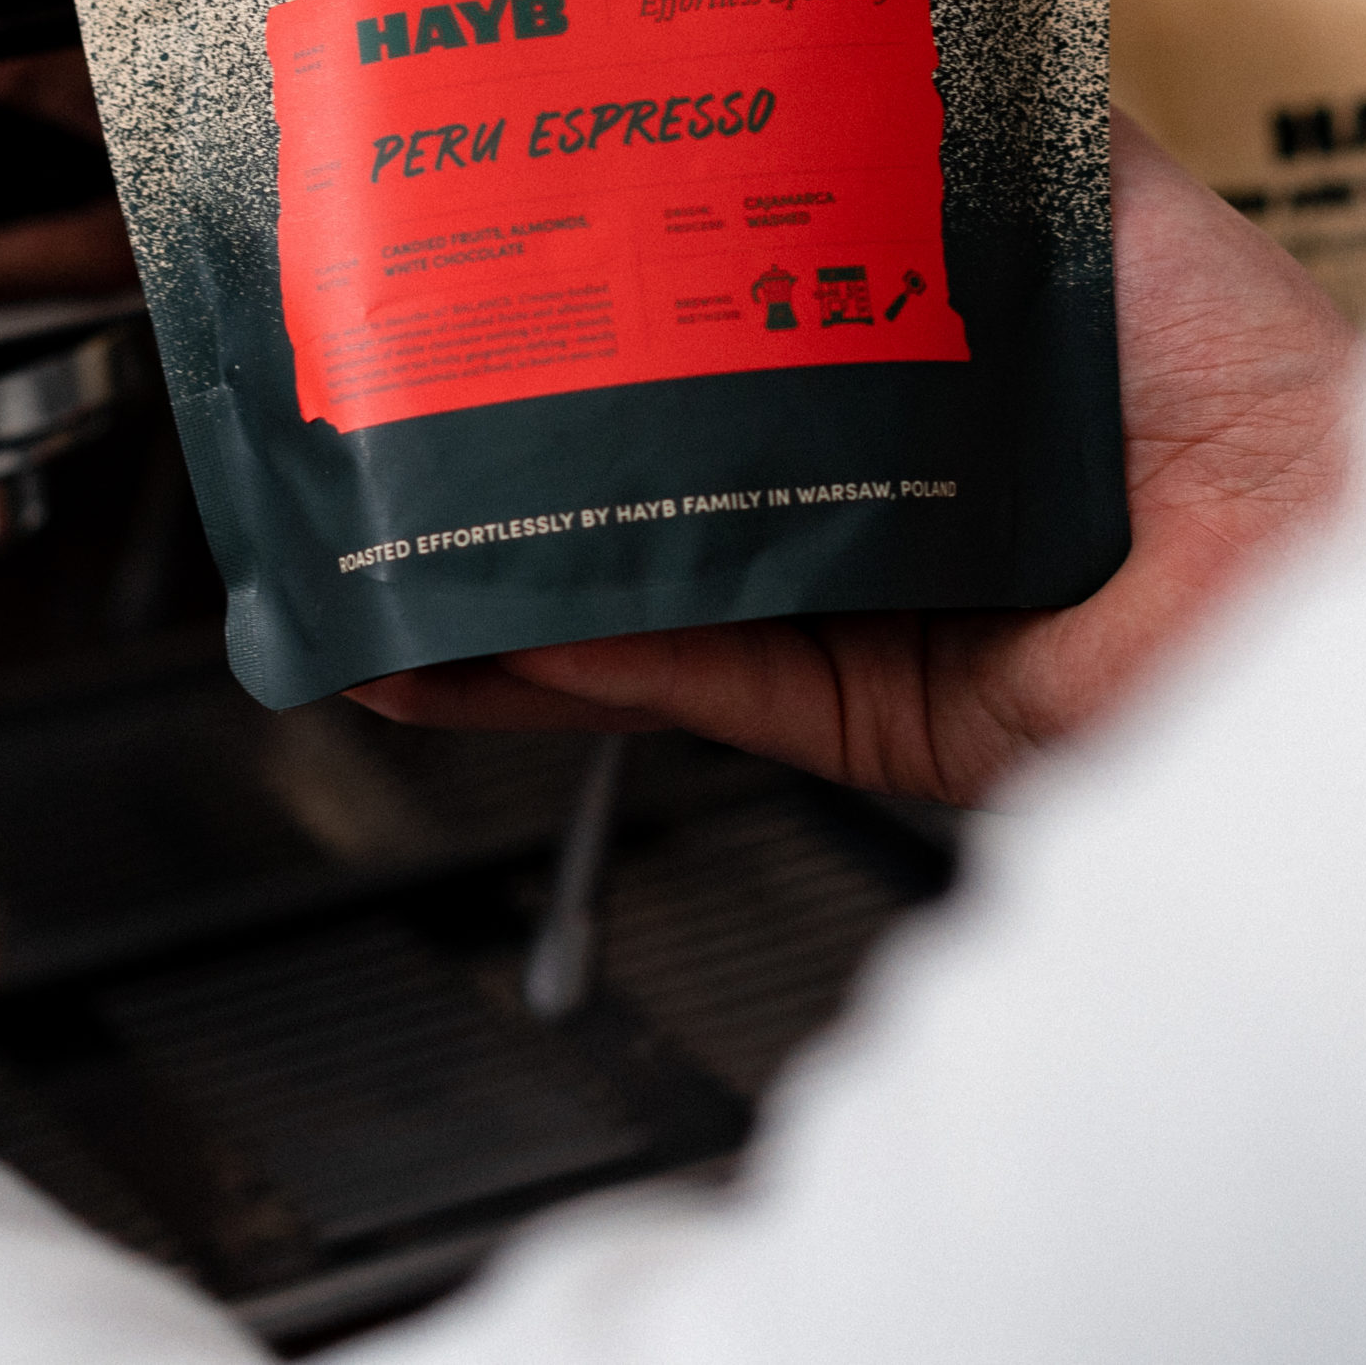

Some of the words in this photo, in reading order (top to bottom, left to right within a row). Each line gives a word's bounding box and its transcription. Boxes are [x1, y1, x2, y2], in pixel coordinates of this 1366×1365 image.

[370, 118, 506, 183] PERU
[529, 89, 776, 159] ESPRESSO
[381, 236, 448, 260] CANDIED
[384, 258, 429, 277] WHITE
[433, 242, 525, 270] CHOCOLATE
[338, 540, 411, 574] ROASTED
[416, 511, 575, 556] EFFORTLESSLY
[580, 507, 610, 529] BY
[615, 498, 677, 523] HAYB
[682, 490, 762, 515] FAMILY
[768, 488, 791, 507] IN
[796, 481, 897, 505] WARSAW,
[900, 480, 957, 498] POLAND
